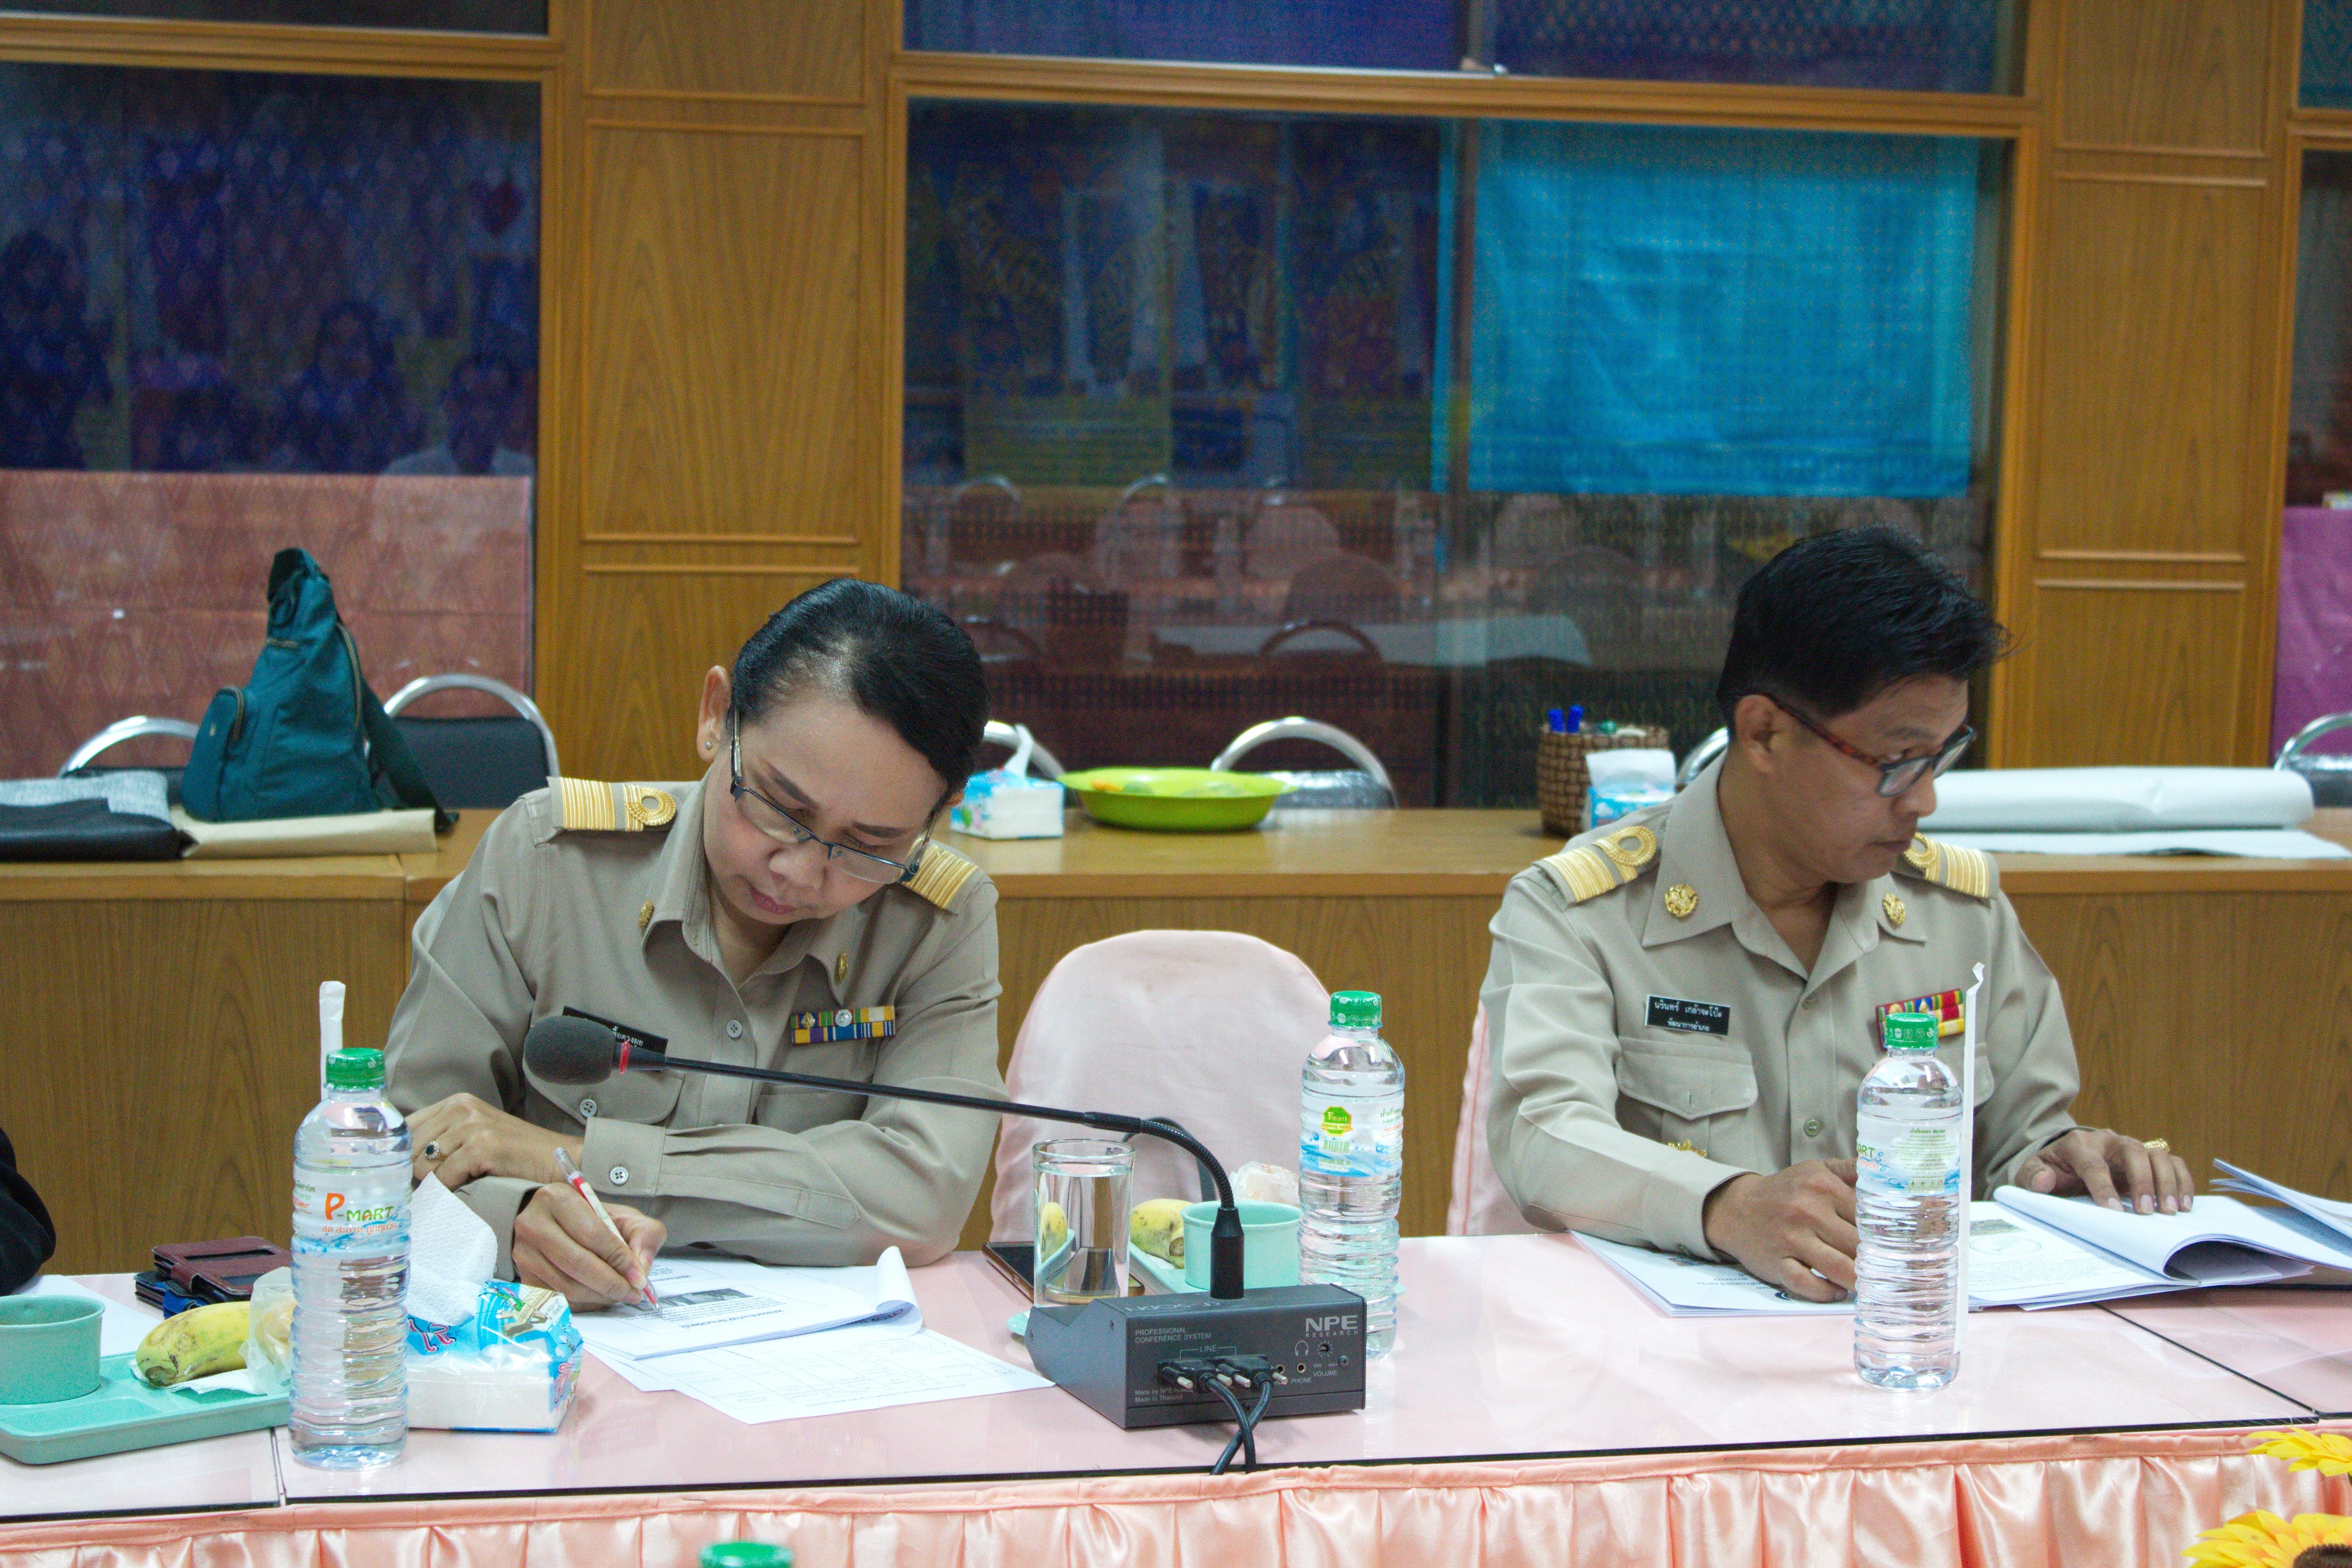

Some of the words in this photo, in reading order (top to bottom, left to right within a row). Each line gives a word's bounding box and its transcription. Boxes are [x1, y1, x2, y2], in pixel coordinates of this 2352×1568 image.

[1856, 1142, 1875, 1158] ART
[325, 1192, 394, 1221] P-MART
[336, 1225, 363, 1234] สะอาด
[366, 1221, 397, 1235] ถูกทุกวัน
[1305, 1315, 1358, 1332] NPE
[1135, 1327, 1187, 1336] PROFESSIONAL
[1305, 1330, 1358, 1338] RESEARCH
[1135, 1335, 1181, 1343] CONFERENCE
